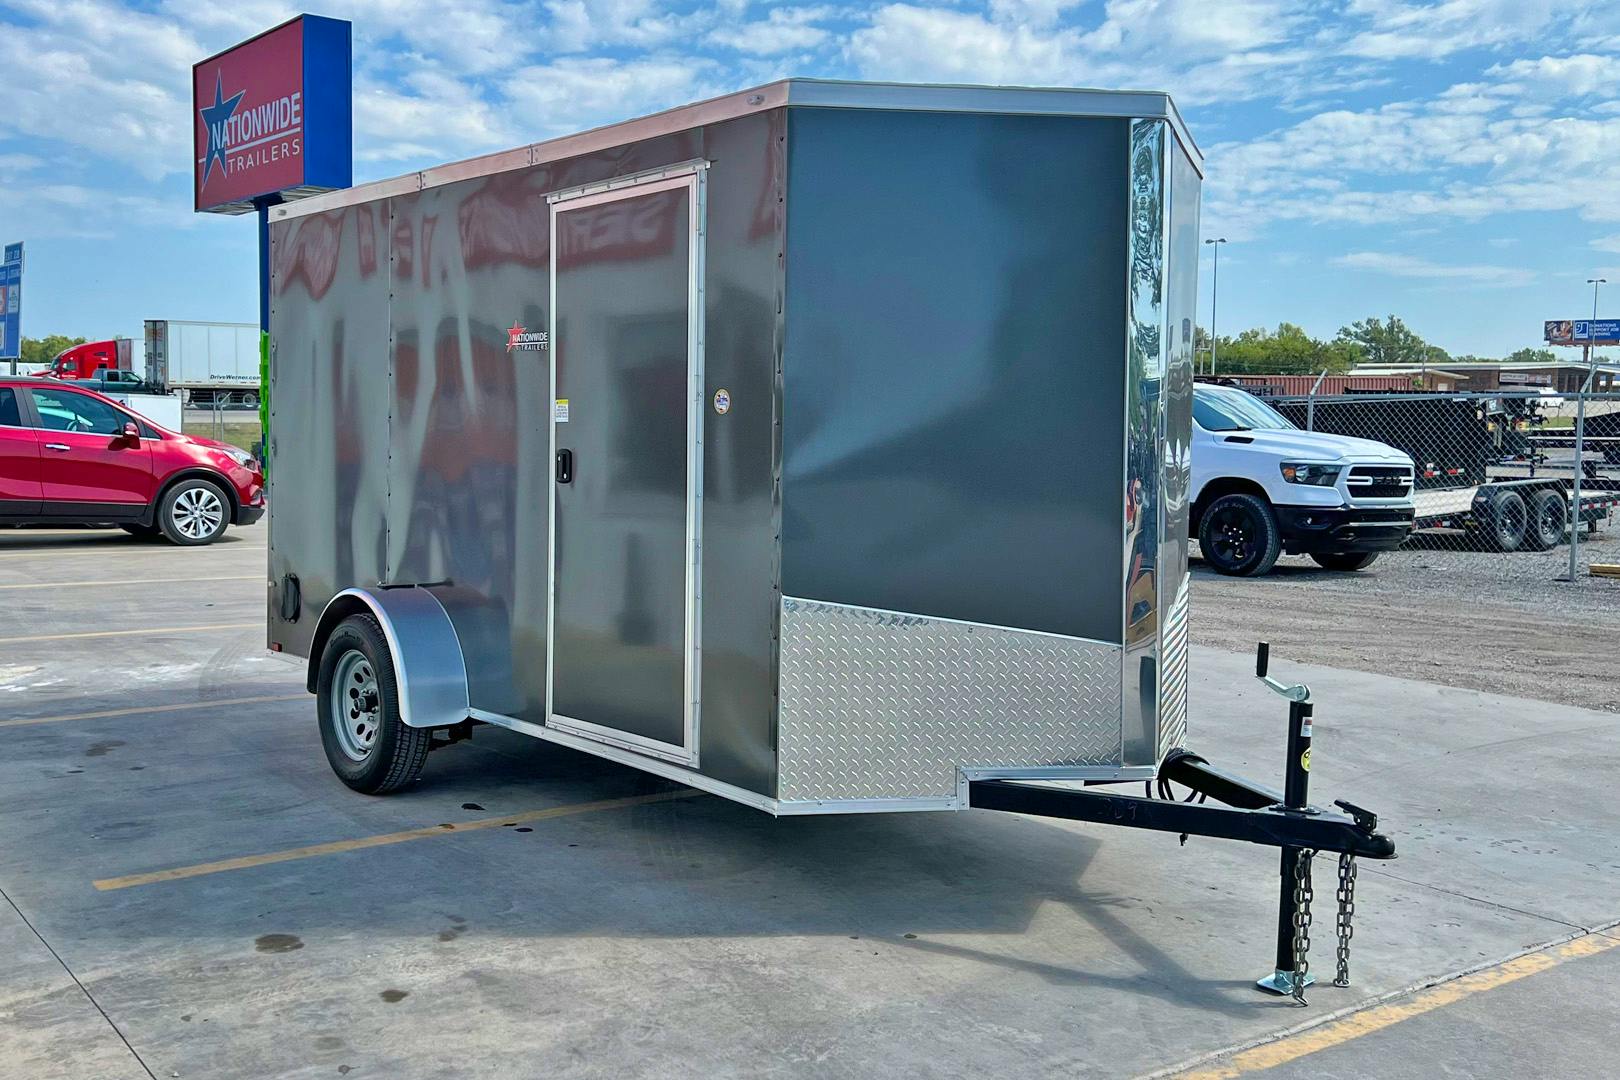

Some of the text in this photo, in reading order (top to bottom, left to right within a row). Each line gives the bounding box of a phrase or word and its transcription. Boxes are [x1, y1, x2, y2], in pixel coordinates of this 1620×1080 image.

[212, 92, 301, 151] NATIONWIDE
[228, 138, 300, 173] TRAILERS
[512, 332, 548, 342] NATIONWIDE
